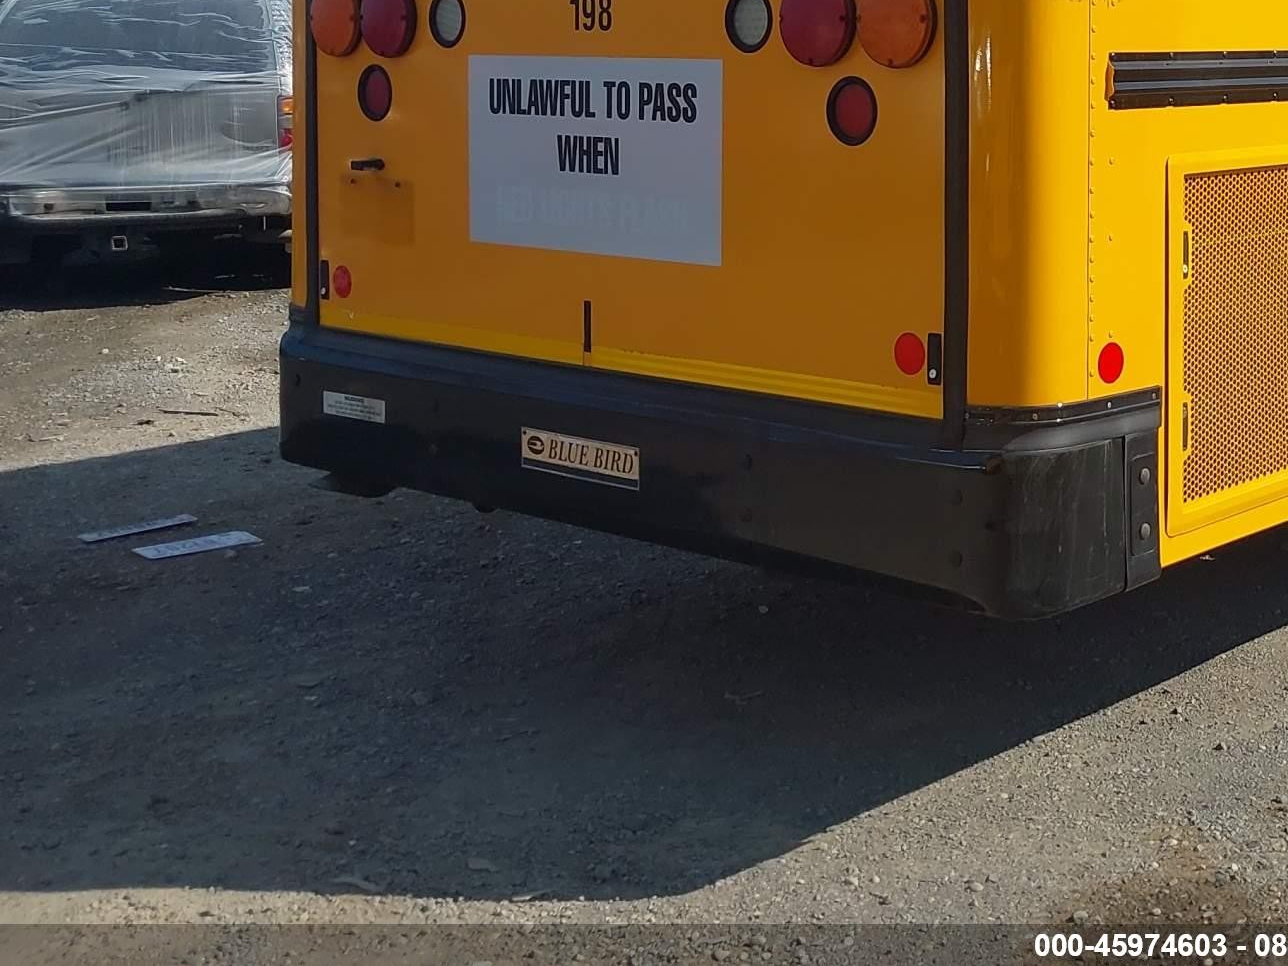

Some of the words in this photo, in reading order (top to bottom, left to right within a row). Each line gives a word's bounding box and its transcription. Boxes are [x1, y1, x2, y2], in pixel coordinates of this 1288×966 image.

[488, 77, 596, 119] UNLAWFUL
[602, 80, 631, 120] TO
[638, 82, 698, 123] PASS
[556, 134, 620, 176] WHEN
[548, 438, 590, 467] BLUE
[593, 447, 634, 474] BIRD
